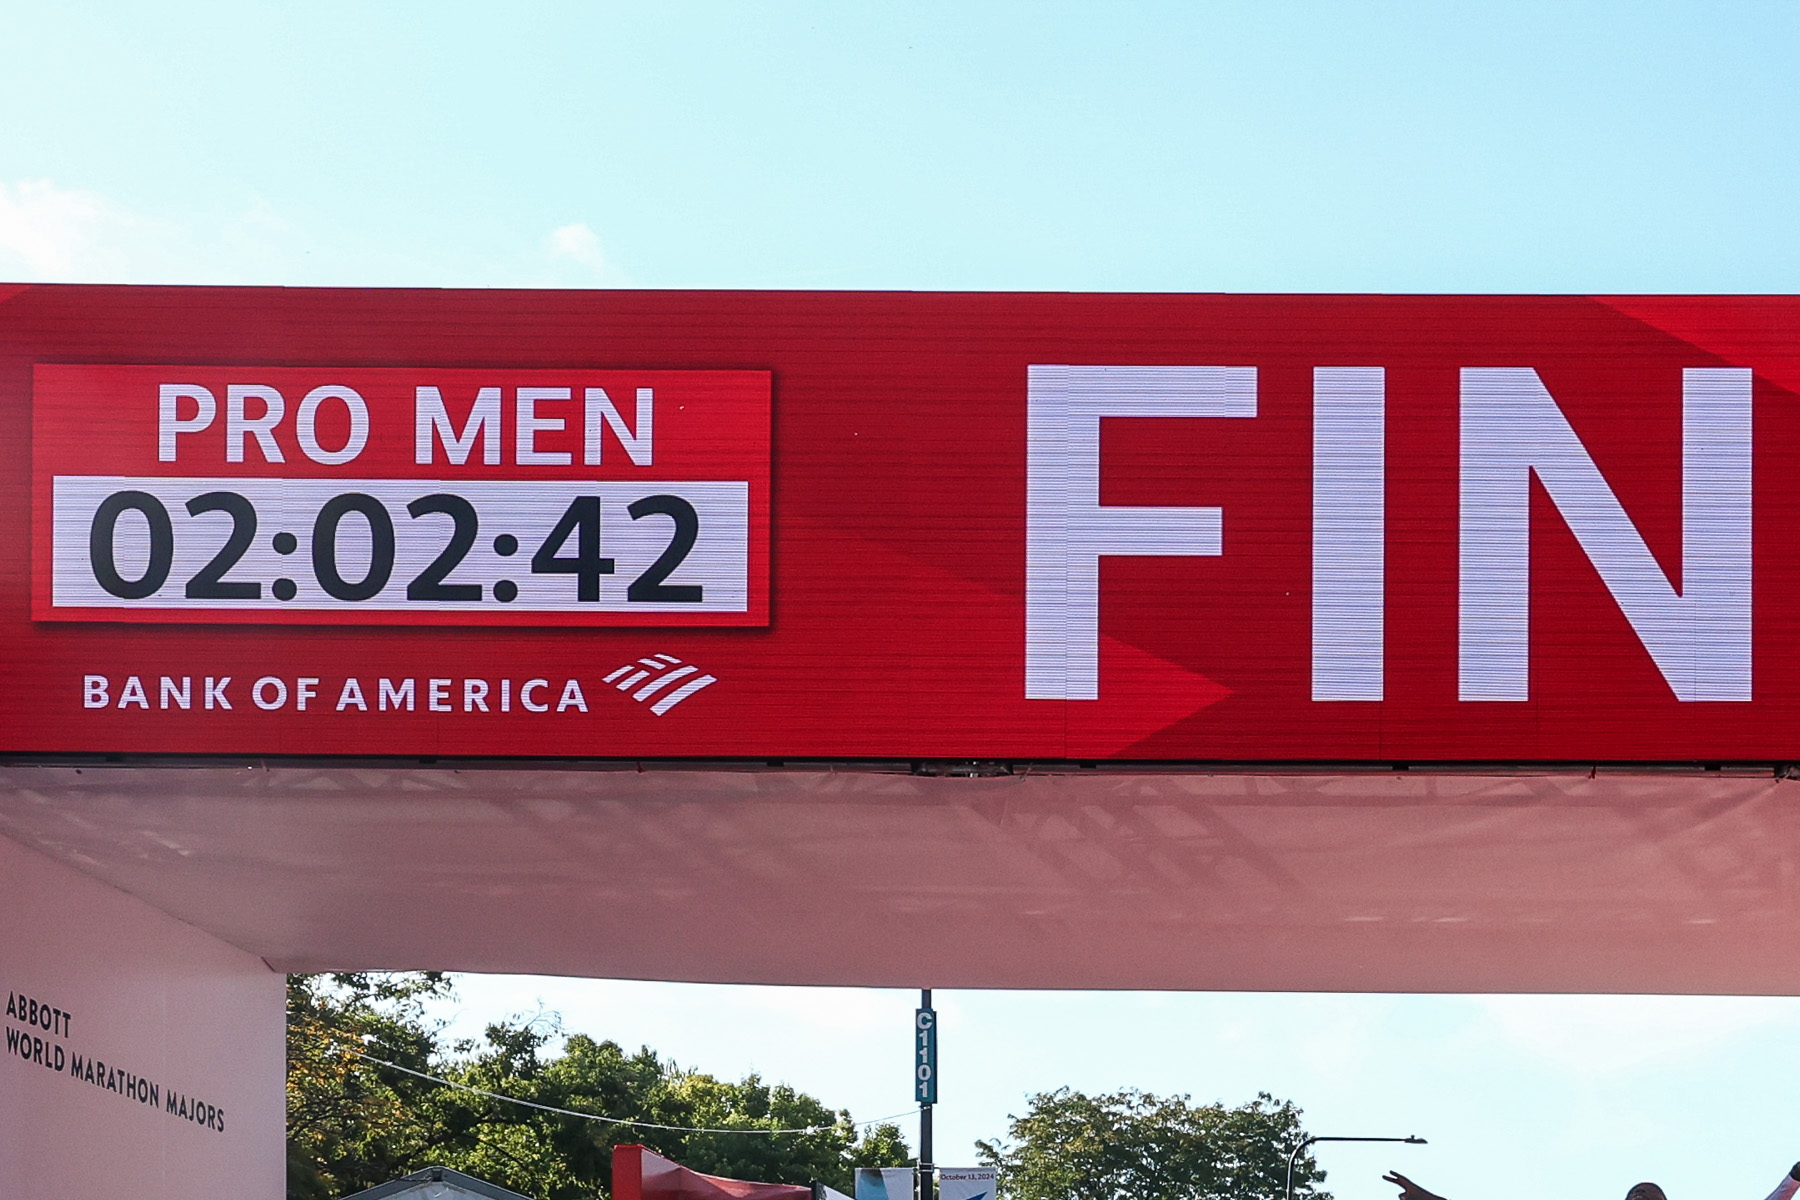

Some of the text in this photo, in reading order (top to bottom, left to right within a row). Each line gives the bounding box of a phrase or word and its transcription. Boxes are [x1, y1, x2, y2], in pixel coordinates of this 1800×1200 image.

[157, 382, 655, 467] PRO MEN
[88, 489, 704, 604] 02:02:42
[82, 674, 589, 713] BANK OF AMERICA
[5, 990, 72, 1039] ABBOTT
[916, 1012, 934, 1098] C1101
[5, 1025, 226, 1133] WORLD MARATHON MAJORS
[940, 1173, 966, 1181] October
